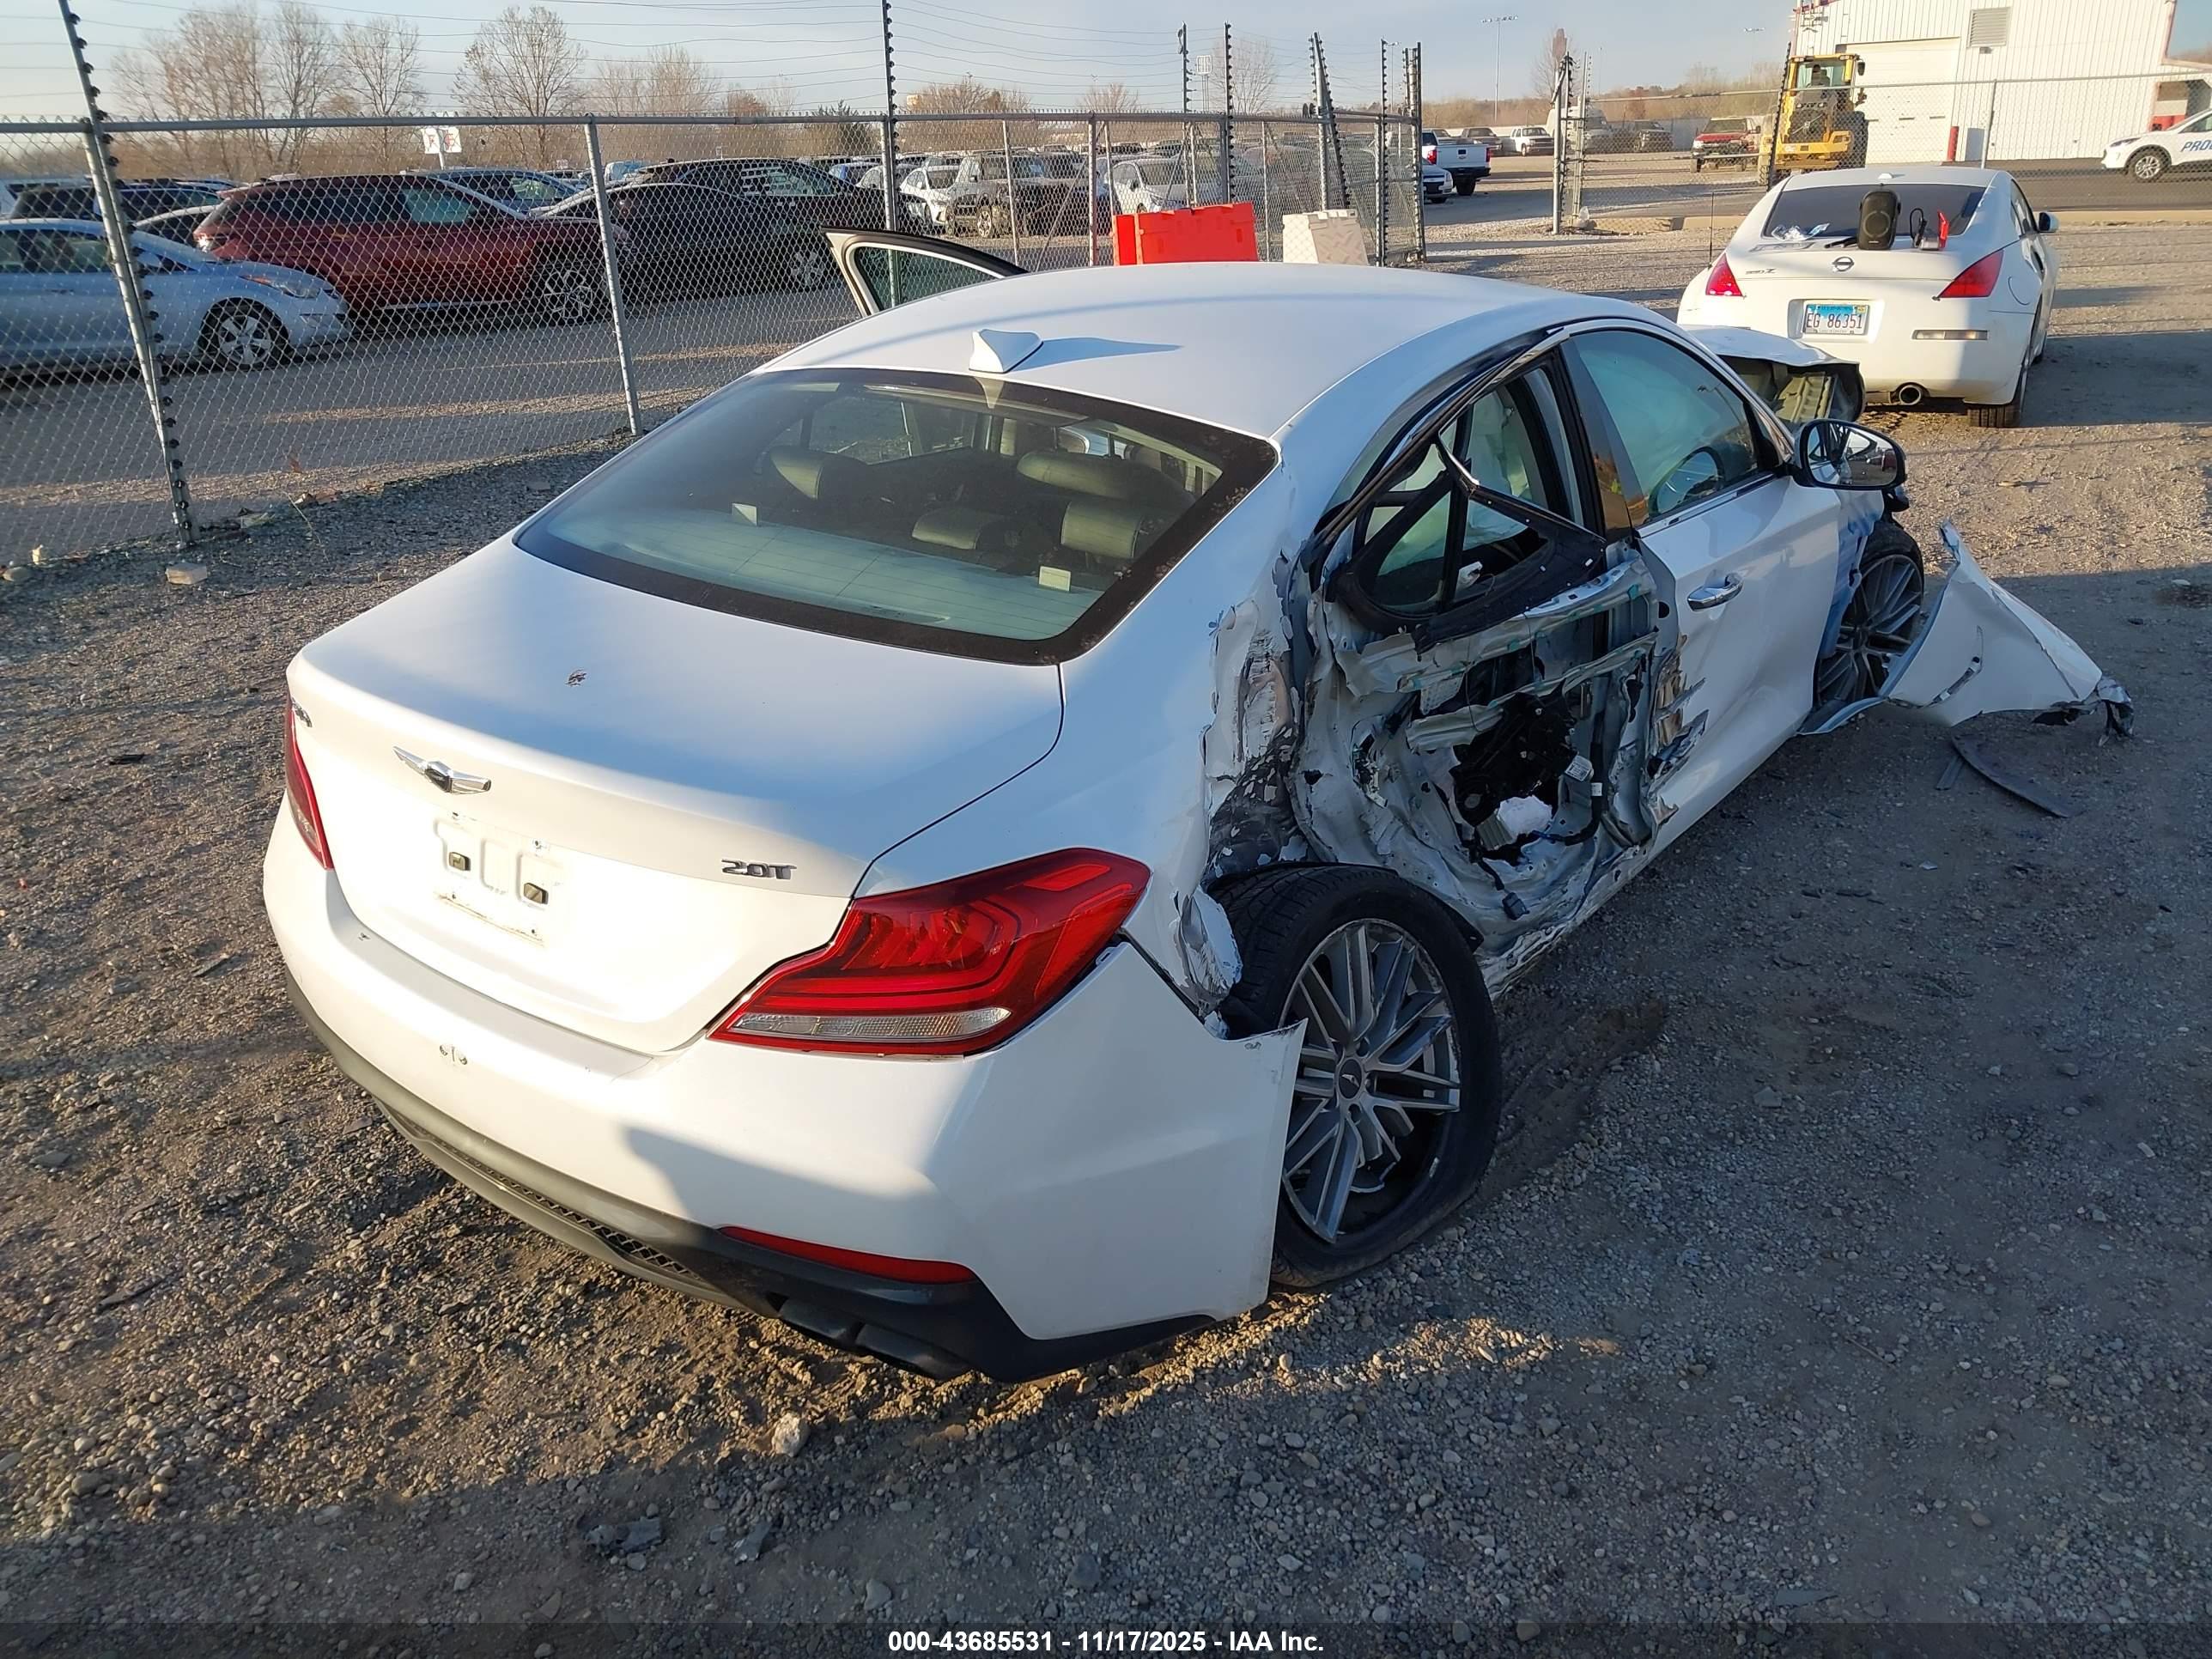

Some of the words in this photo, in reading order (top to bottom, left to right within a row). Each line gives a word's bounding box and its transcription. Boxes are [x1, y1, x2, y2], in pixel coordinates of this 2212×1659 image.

[2180, 139, 2212, 152] PRO
[1806, 313, 1820, 328] EG
[1827, 313, 1863, 329] 86351
